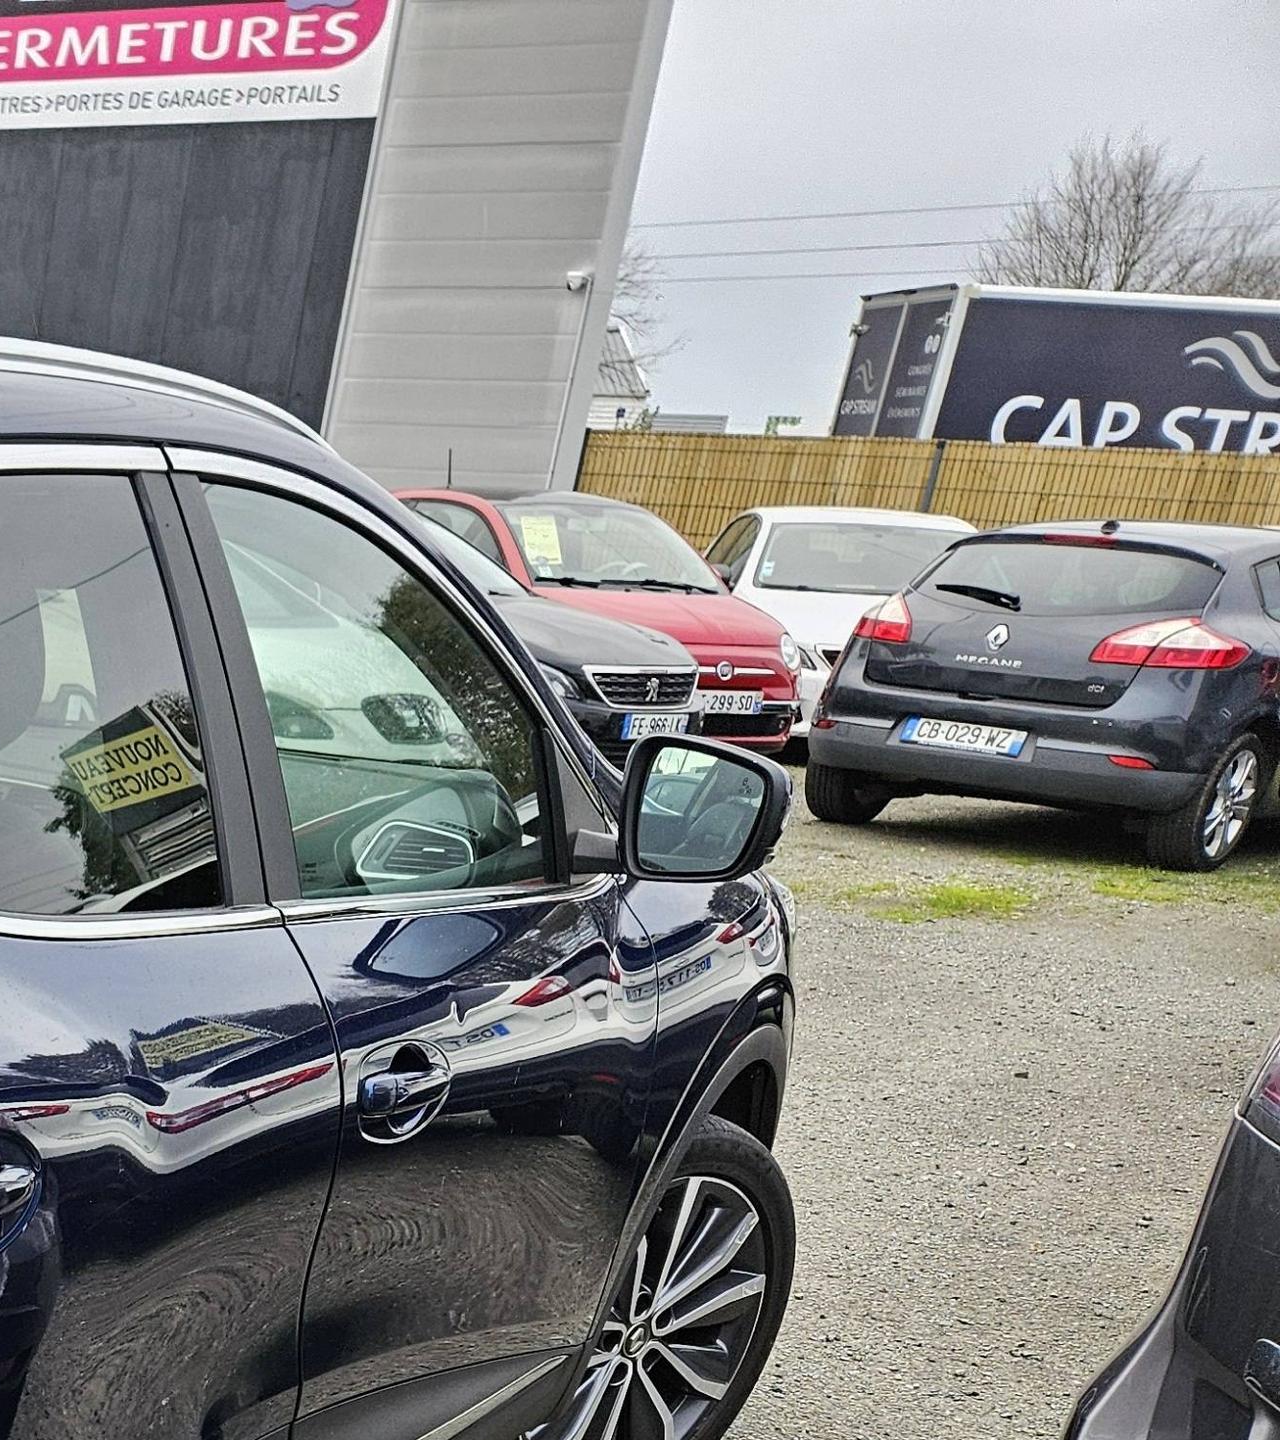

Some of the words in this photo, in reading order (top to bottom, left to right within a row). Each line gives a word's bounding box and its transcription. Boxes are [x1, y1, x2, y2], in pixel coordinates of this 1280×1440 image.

[129, 91, 153, 109] DE
[991, 395, 1140, 448] CAP
[701, 693, 753, 711] -299-SD
[916, 720, 1012, 749] CB-029-WZ
